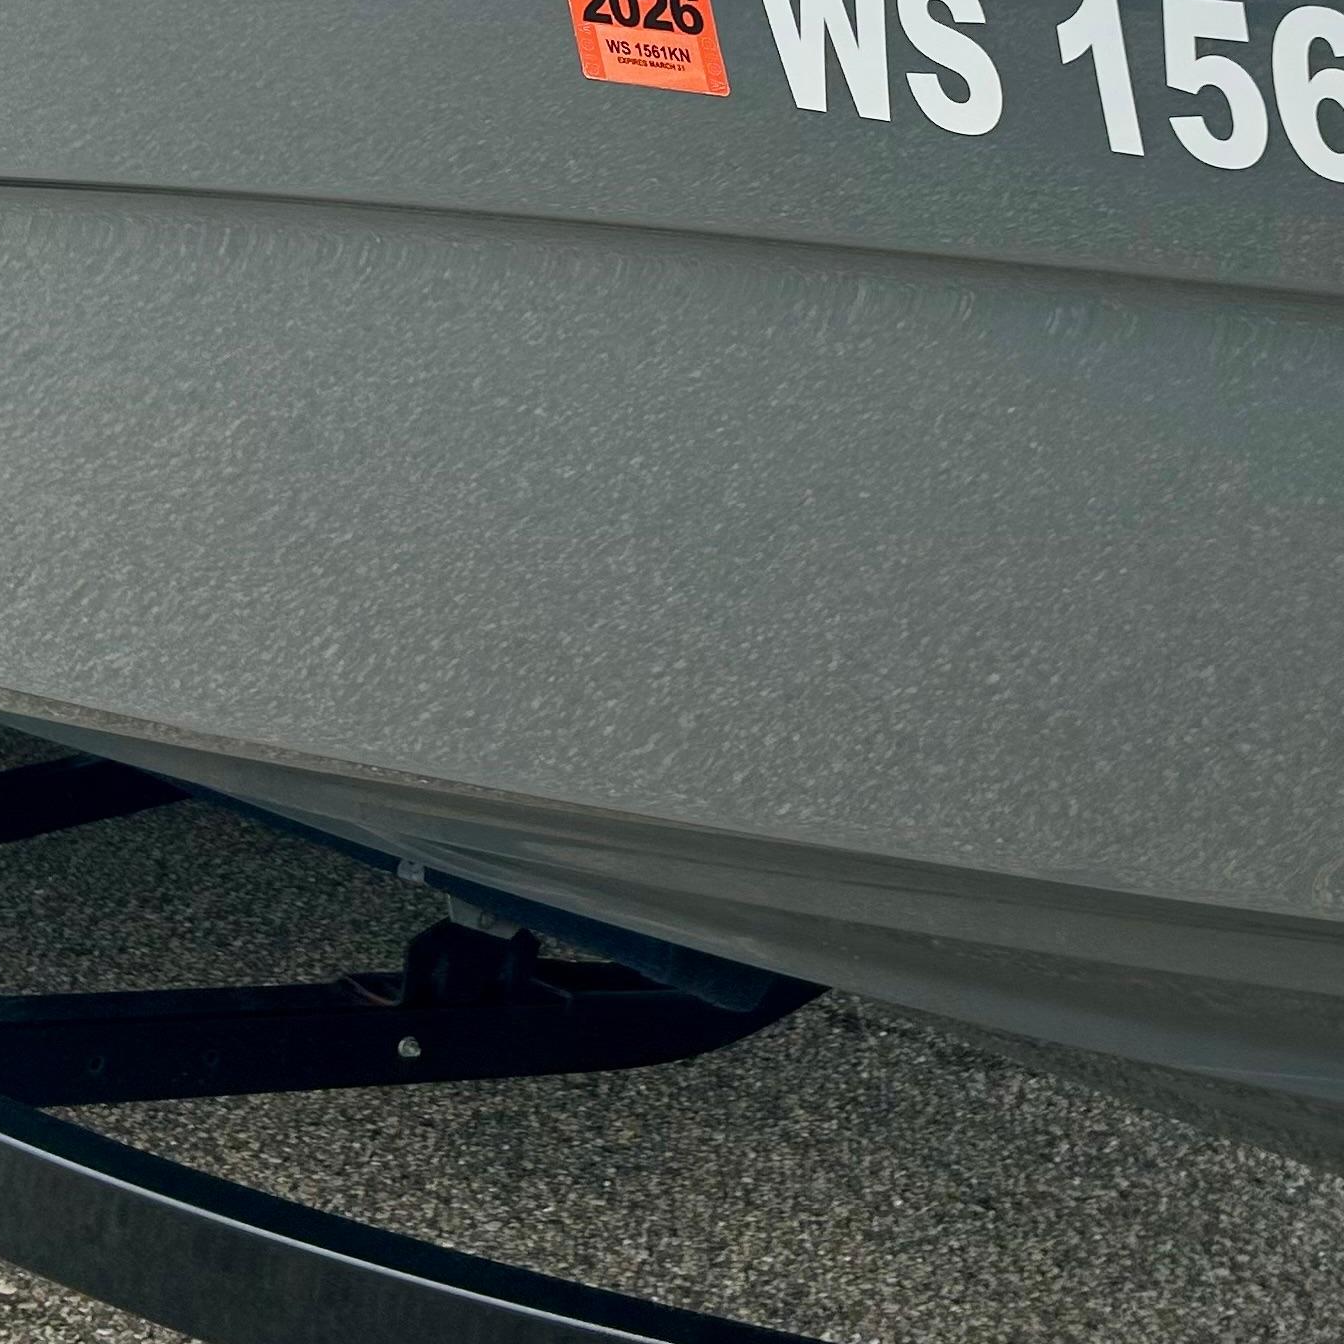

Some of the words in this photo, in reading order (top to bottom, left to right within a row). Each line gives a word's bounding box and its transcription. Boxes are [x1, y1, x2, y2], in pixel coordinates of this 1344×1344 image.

[605, 38, 632, 56] WS
[634, 42, 692, 64] 1561KN
[617, 56, 648, 68] EXPIRES
